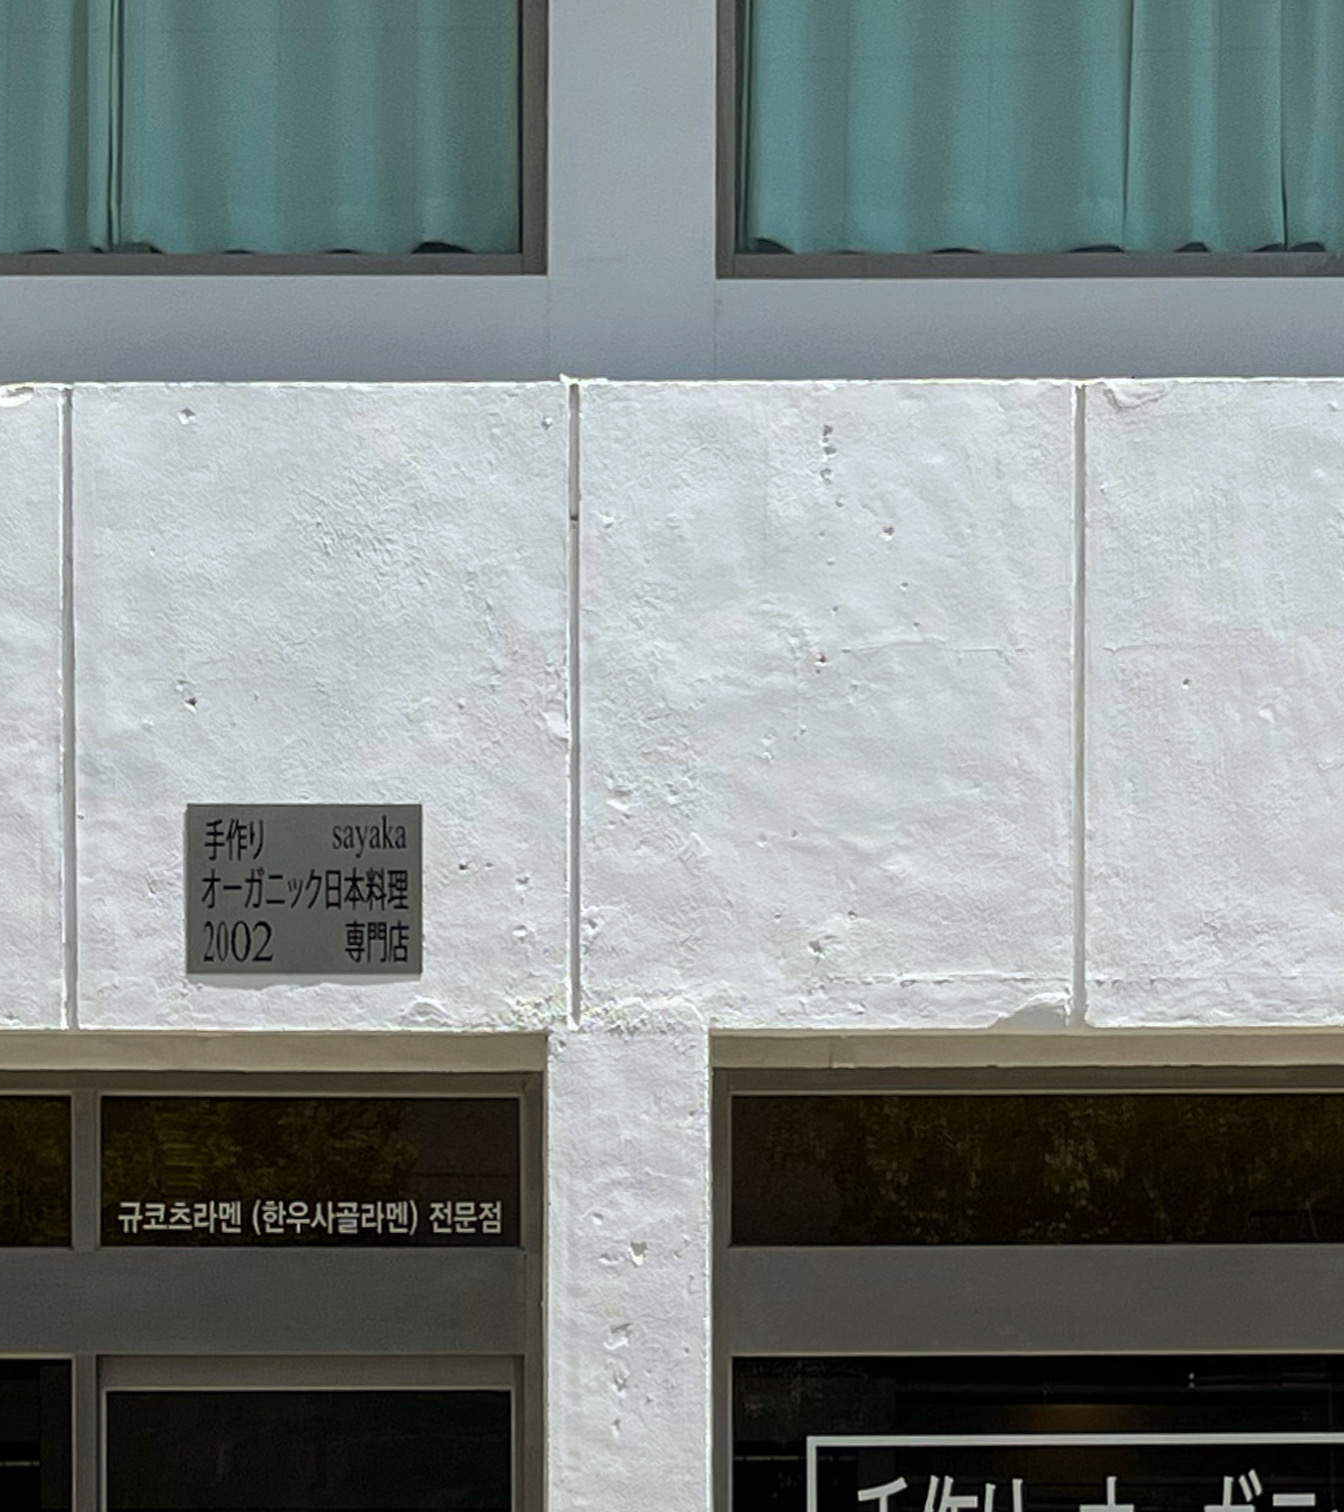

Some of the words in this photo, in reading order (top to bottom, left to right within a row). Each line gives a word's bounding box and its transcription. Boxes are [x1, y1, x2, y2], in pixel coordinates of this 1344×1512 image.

[204, 818, 264, 861] 手作り
[332, 815, 407, 858] sayaka
[201, 866, 409, 911] オーガニック日本料理
[203, 920, 274, 962] 2002
[345, 920, 410, 963] 専門店
[117, 1200, 242, 1235] 규코츠라멘
[252, 1200, 418, 1236] (한우사골라멘)
[428, 1200, 503, 1235] 전문점
